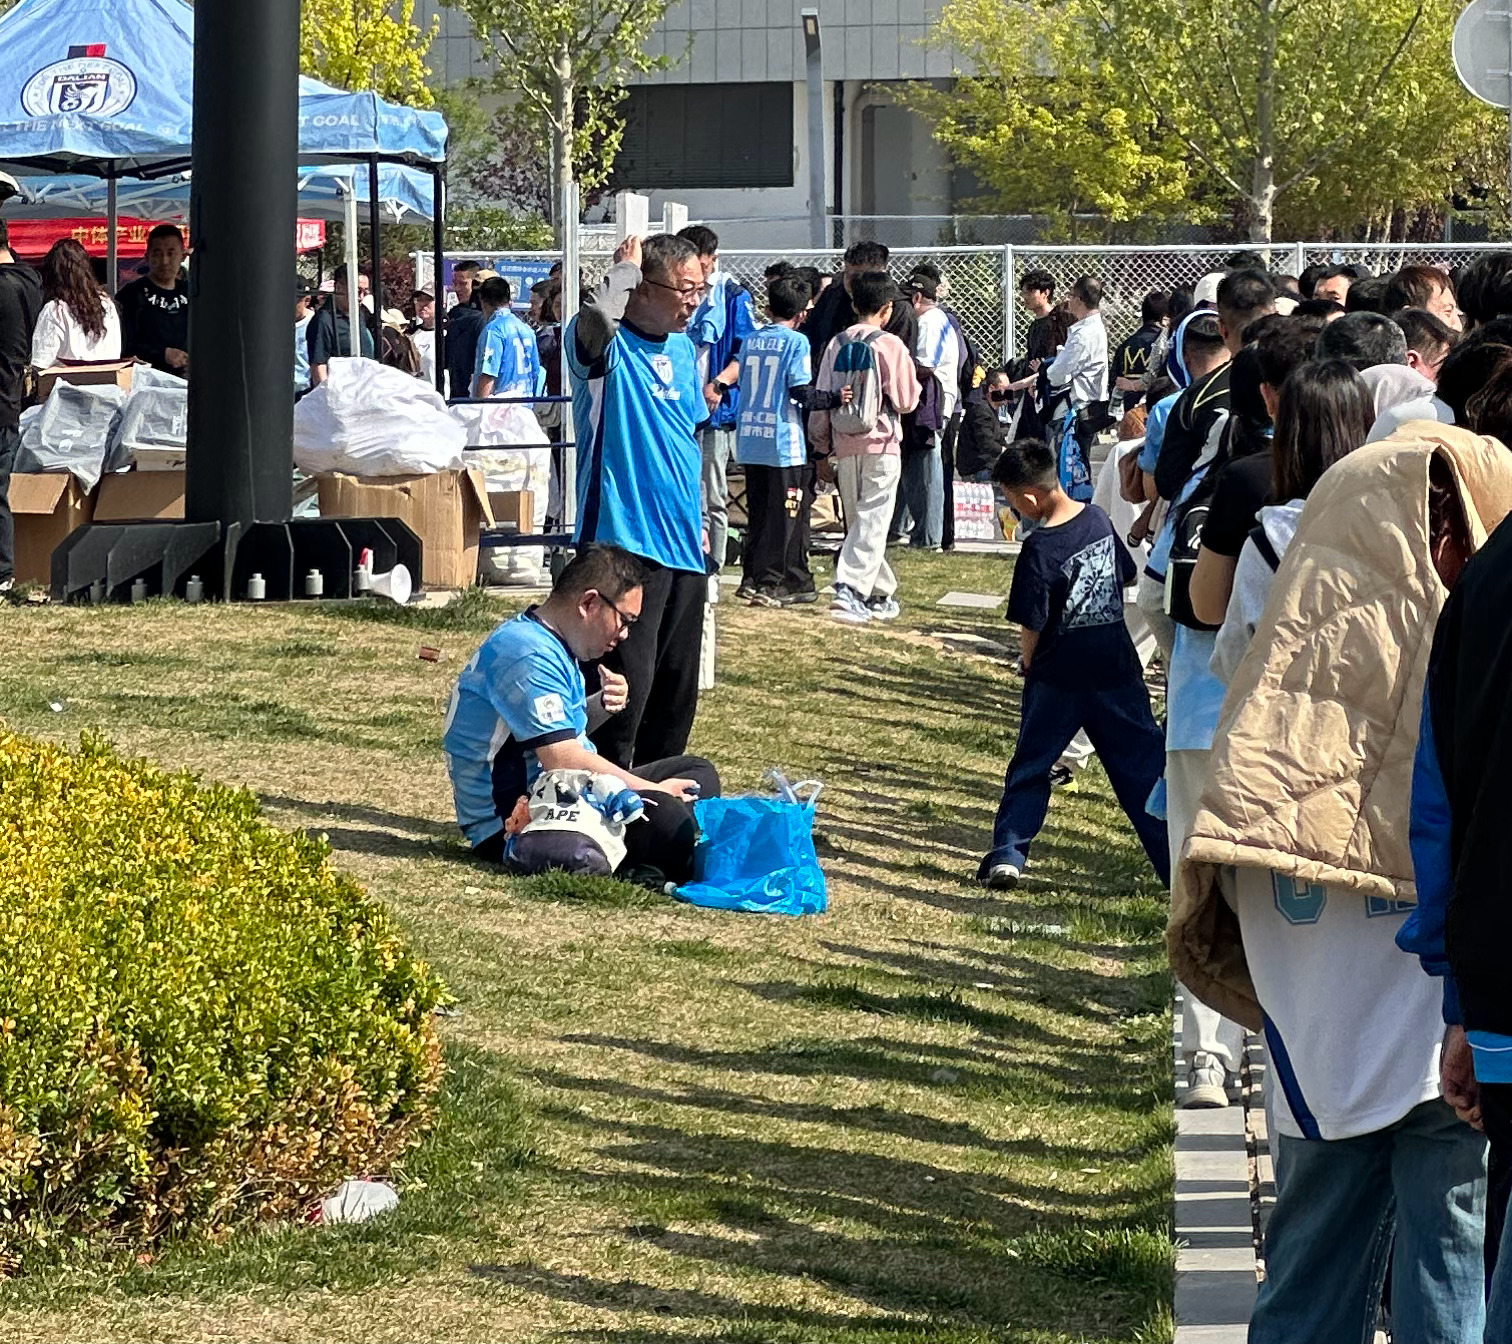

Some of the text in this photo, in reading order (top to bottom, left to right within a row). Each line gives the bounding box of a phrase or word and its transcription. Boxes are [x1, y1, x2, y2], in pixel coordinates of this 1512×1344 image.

[313, 114, 360, 127] GOAL
[746, 355, 780, 409] 11
[544, 808, 581, 823] APE
